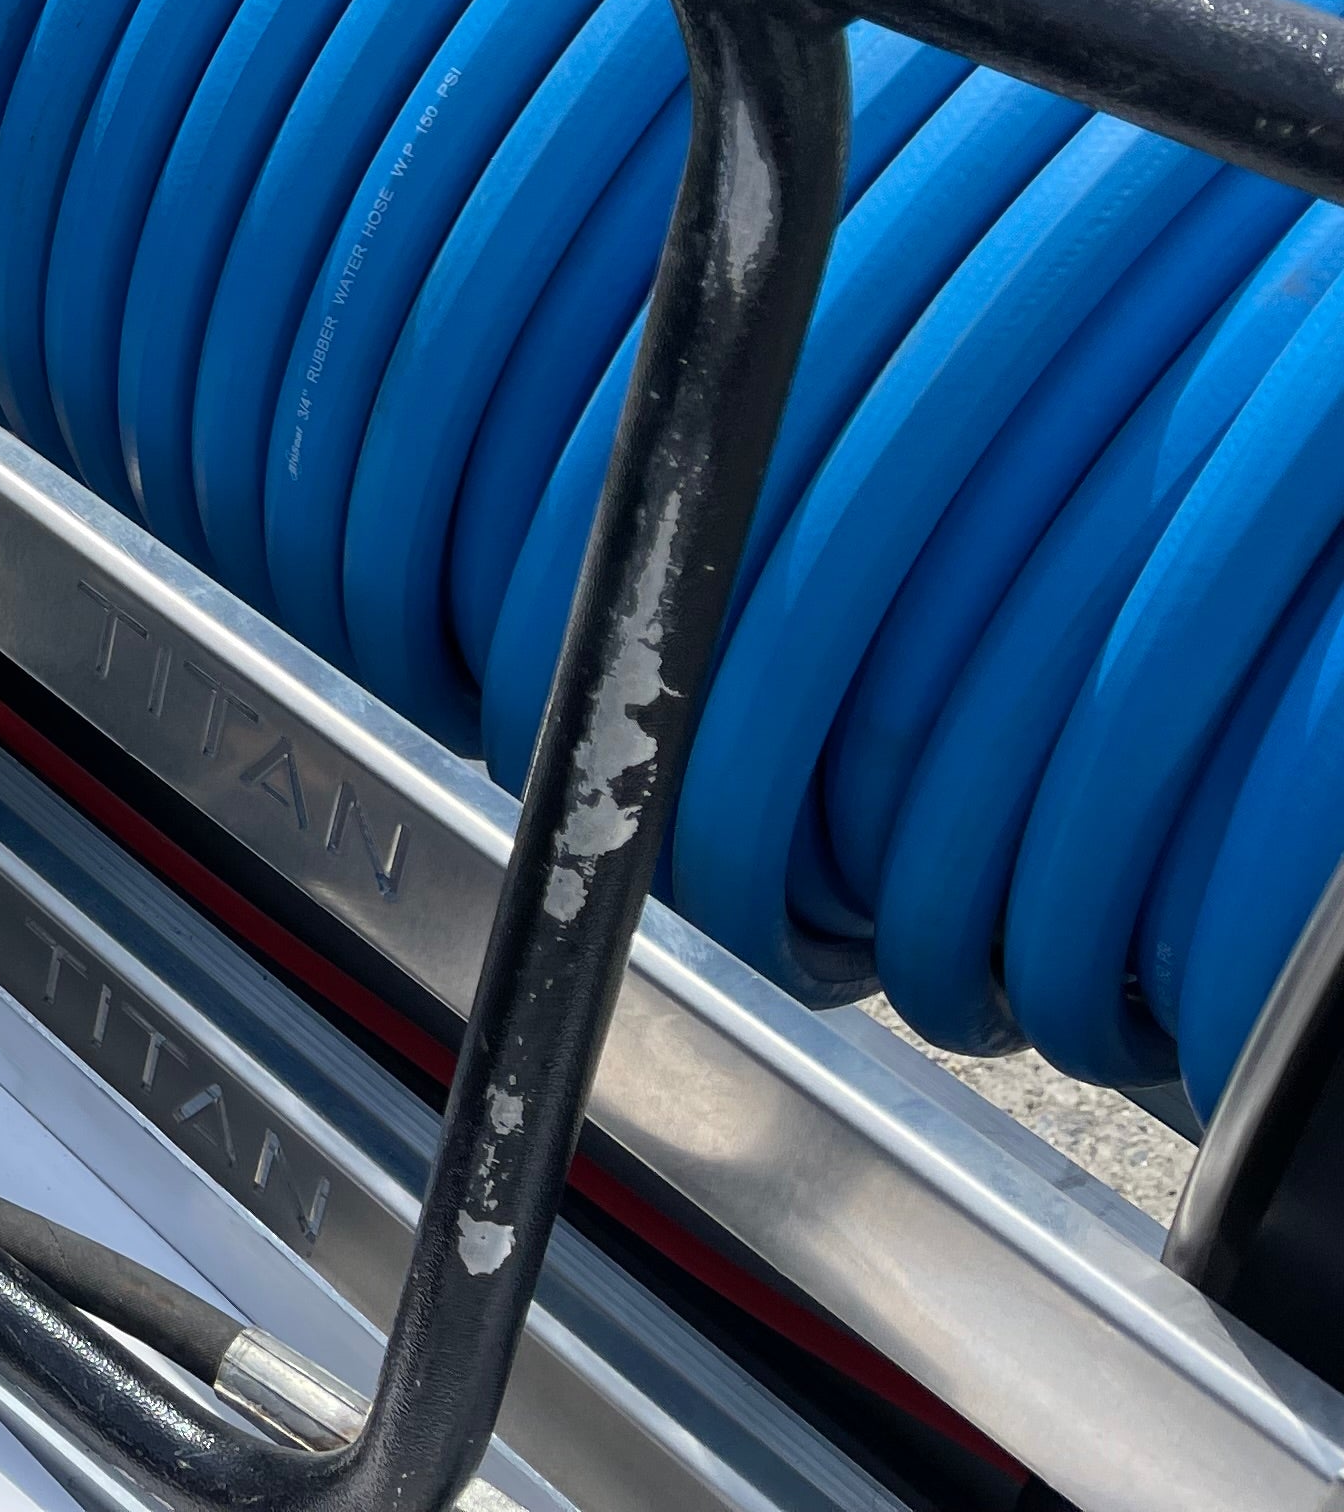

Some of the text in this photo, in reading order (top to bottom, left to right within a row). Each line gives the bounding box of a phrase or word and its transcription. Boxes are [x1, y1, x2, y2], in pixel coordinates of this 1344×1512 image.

[306, 316, 339, 384] RUBBER
[332, 244, 368, 306] WATER
[361, 186, 394, 239] HOSE
[415, 105, 439, 134] 150
[436, 66, 463, 99] PSI
[77, 578, 410, 903] TITAN
[24, 916, 332, 1245] TITAN
